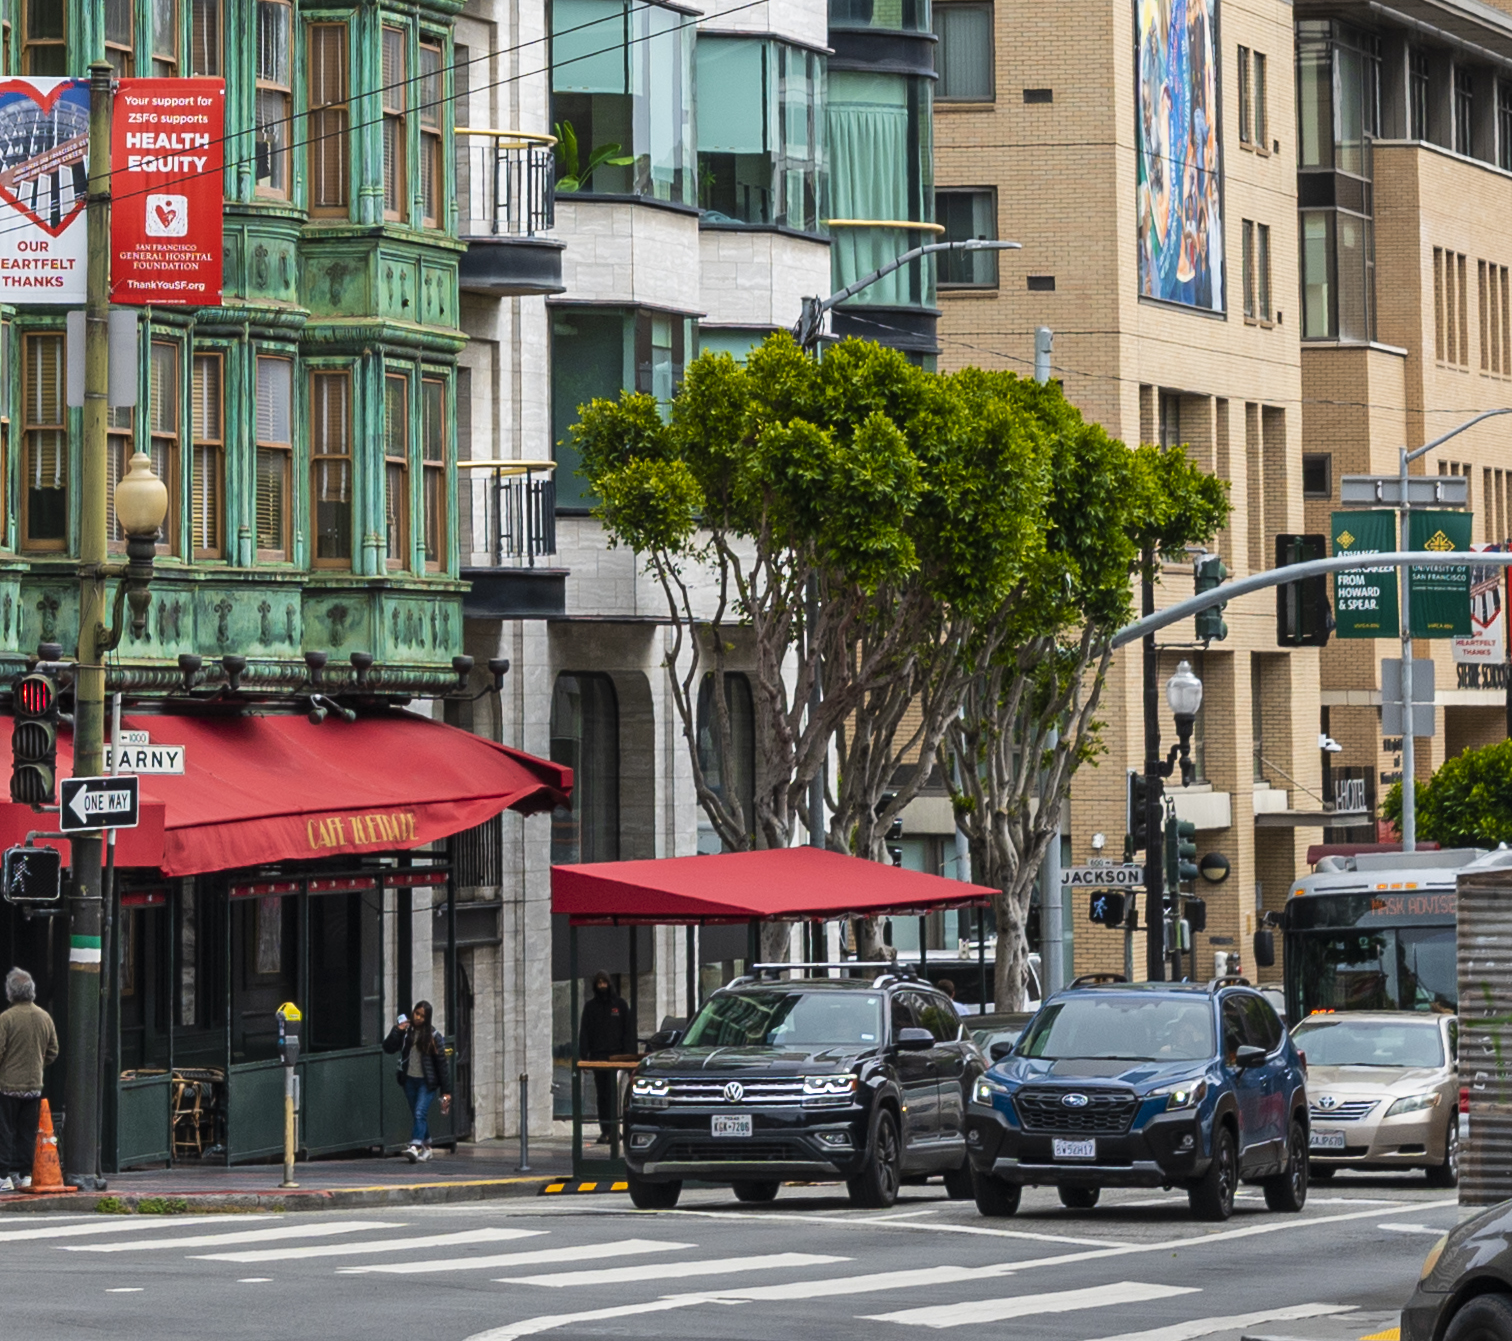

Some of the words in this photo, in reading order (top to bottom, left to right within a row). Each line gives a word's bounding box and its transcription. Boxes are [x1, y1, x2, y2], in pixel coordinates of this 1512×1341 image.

[124, 96, 150, 106] Your
[152, 96, 194, 108] support
[197, 95, 213, 106] for
[128, 113, 158, 124] ZSFG
[160, 113, 209, 125] supports
[125, 132, 210, 149] HEALTH
[127, 156, 208, 173] EQUITY
[17, 240, 49, 253] OUR
[135, 243, 151, 252] SAN
[152, 243, 197, 252] FRANCISCO
[119, 252, 163, 261] GENERAL
[165, 252, 213, 261] HOSPITAL
[133, 261, 199, 270] FOUNDATION
[2, 275, 64, 288] THANKS
[126, 279, 205, 292] ThankYouSF.org
[1337, 574, 1366, 586] FROM
[1427, 573, 1467, 582] FRANCISCO
[1338, 586, 1380, 598] HOWARD
[1338, 599, 1347, 610] &
[129, 733, 147, 743] 1000
[84, 794, 104, 811] ONE
[108, 793, 128, 810] WAY
[307, 817, 347, 850] CAFE
[1061, 870, 1139, 885] JACKSON
[1371, 897, 1406, 915] MASK
[1407, 894, 1456, 915] ADVISE
